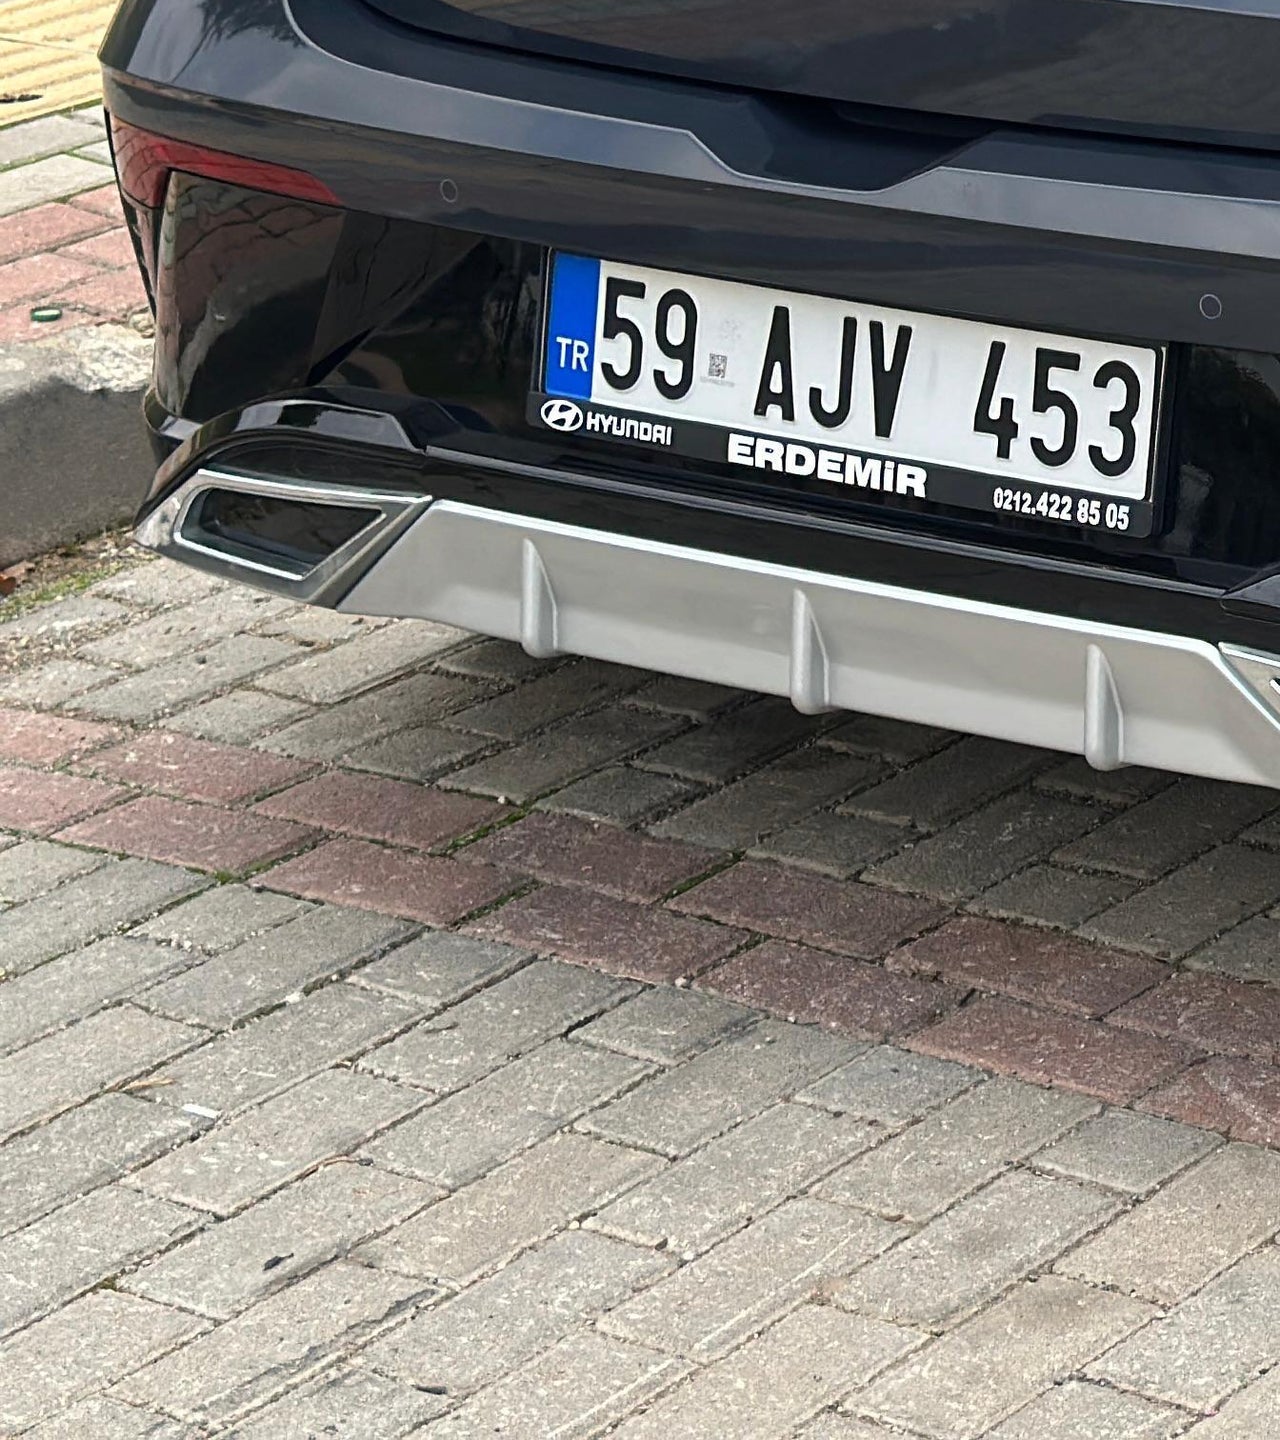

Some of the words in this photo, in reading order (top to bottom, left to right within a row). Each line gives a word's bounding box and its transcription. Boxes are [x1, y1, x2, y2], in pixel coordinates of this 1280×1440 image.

[556, 336, 589, 372] TR
[601, 276, 698, 400] 59
[754, 305, 912, 438] AJV
[973, 341, 1140, 477] 453
[586, 411, 672, 446] HYUNDAI
[993, 488, 1072, 521] 0212.422
[1077, 499, 1100, 524] 85
[1105, 502, 1130, 530] 05
